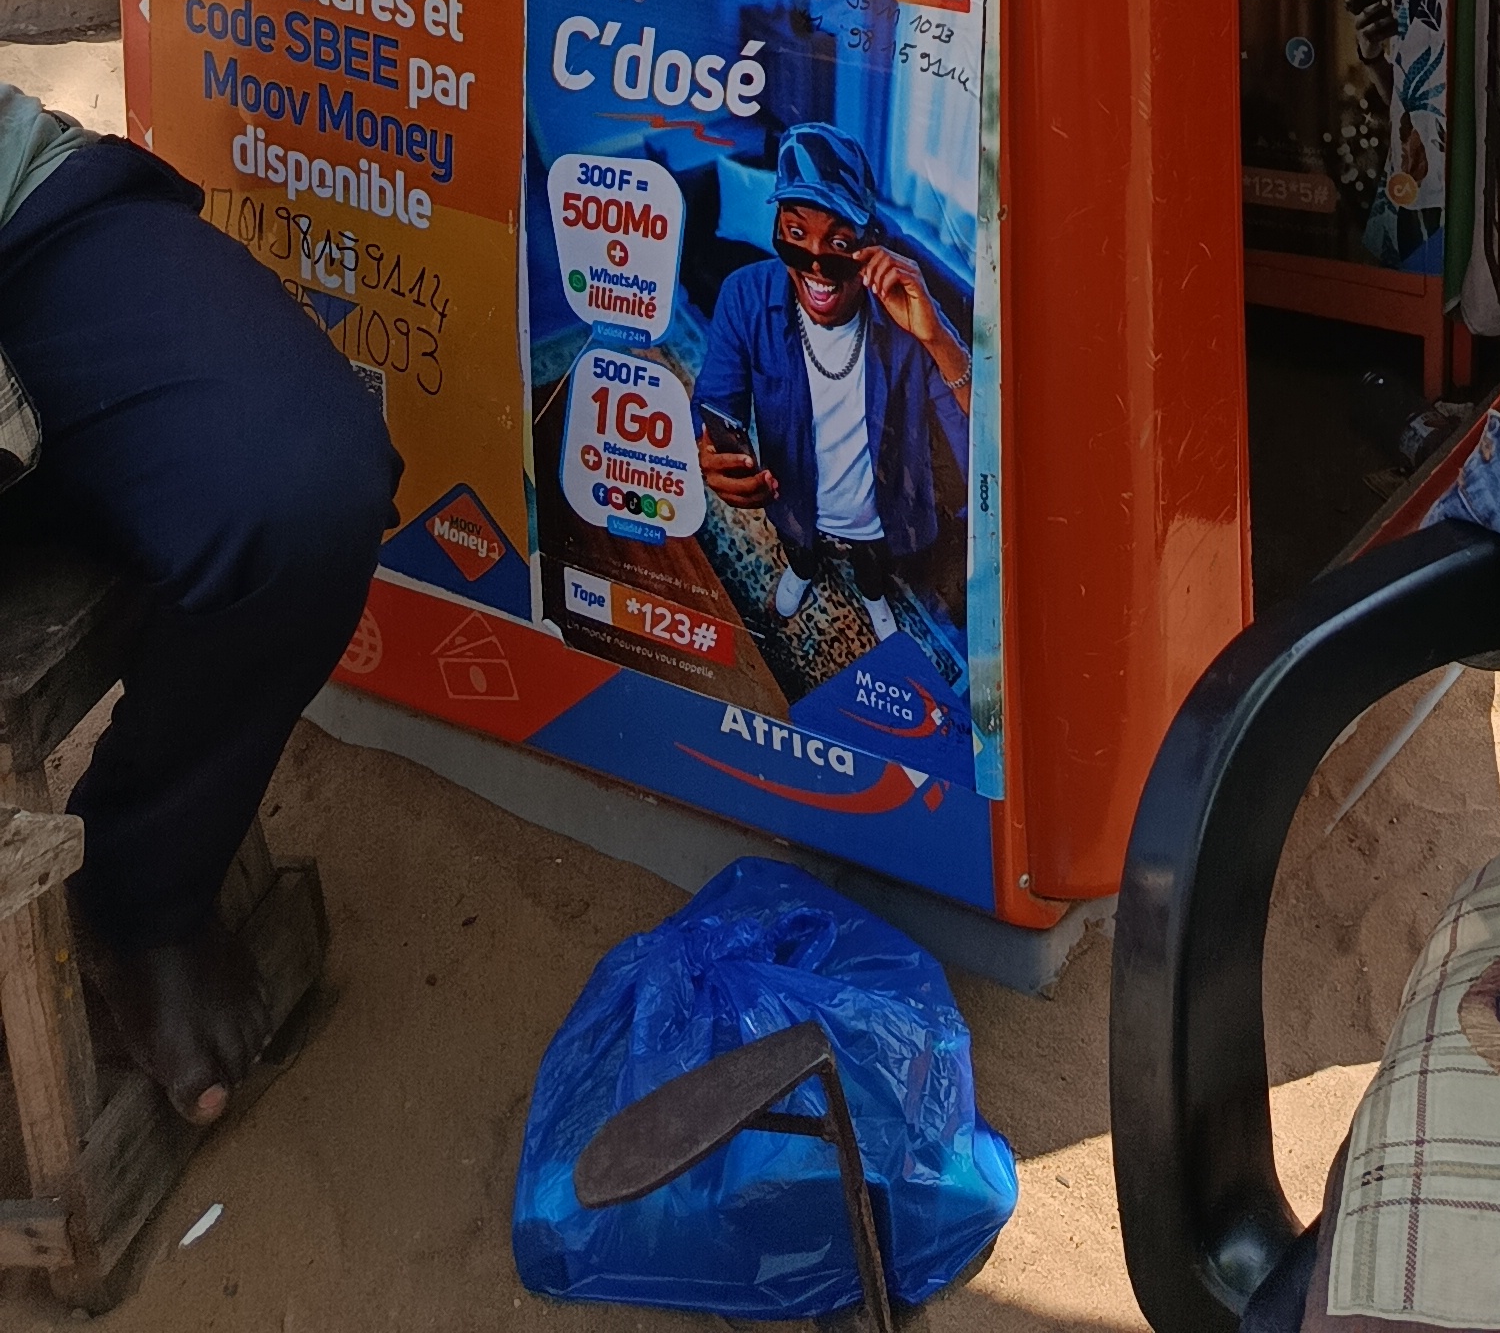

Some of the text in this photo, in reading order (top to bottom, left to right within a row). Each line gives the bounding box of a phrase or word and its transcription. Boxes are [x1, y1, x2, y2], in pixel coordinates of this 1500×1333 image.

[283, 10, 400, 91] SBEE
[409, 57, 476, 110] par
[551, 15, 766, 117] C'dosé
[203, 50, 454, 184] Moov Money
[232, 124, 433, 229] disponible
[576, 162, 632, 192] 300F
[562, 191, 668, 241] 500Mo
[589, 265, 657, 296] WhatsApp
[588, 283, 657, 319] illimité
[593, 357, 648, 388] 500F
[603, 441, 688, 472] Réseaux sociaux
[605, 457, 685, 497] illimités
[433, 517, 488, 558] Money
[571, 581, 606, 608] Tape
[654, 651, 677, 667] vous
[855, 669, 913, 703] Moov
[855, 688, 914, 722] Africa
